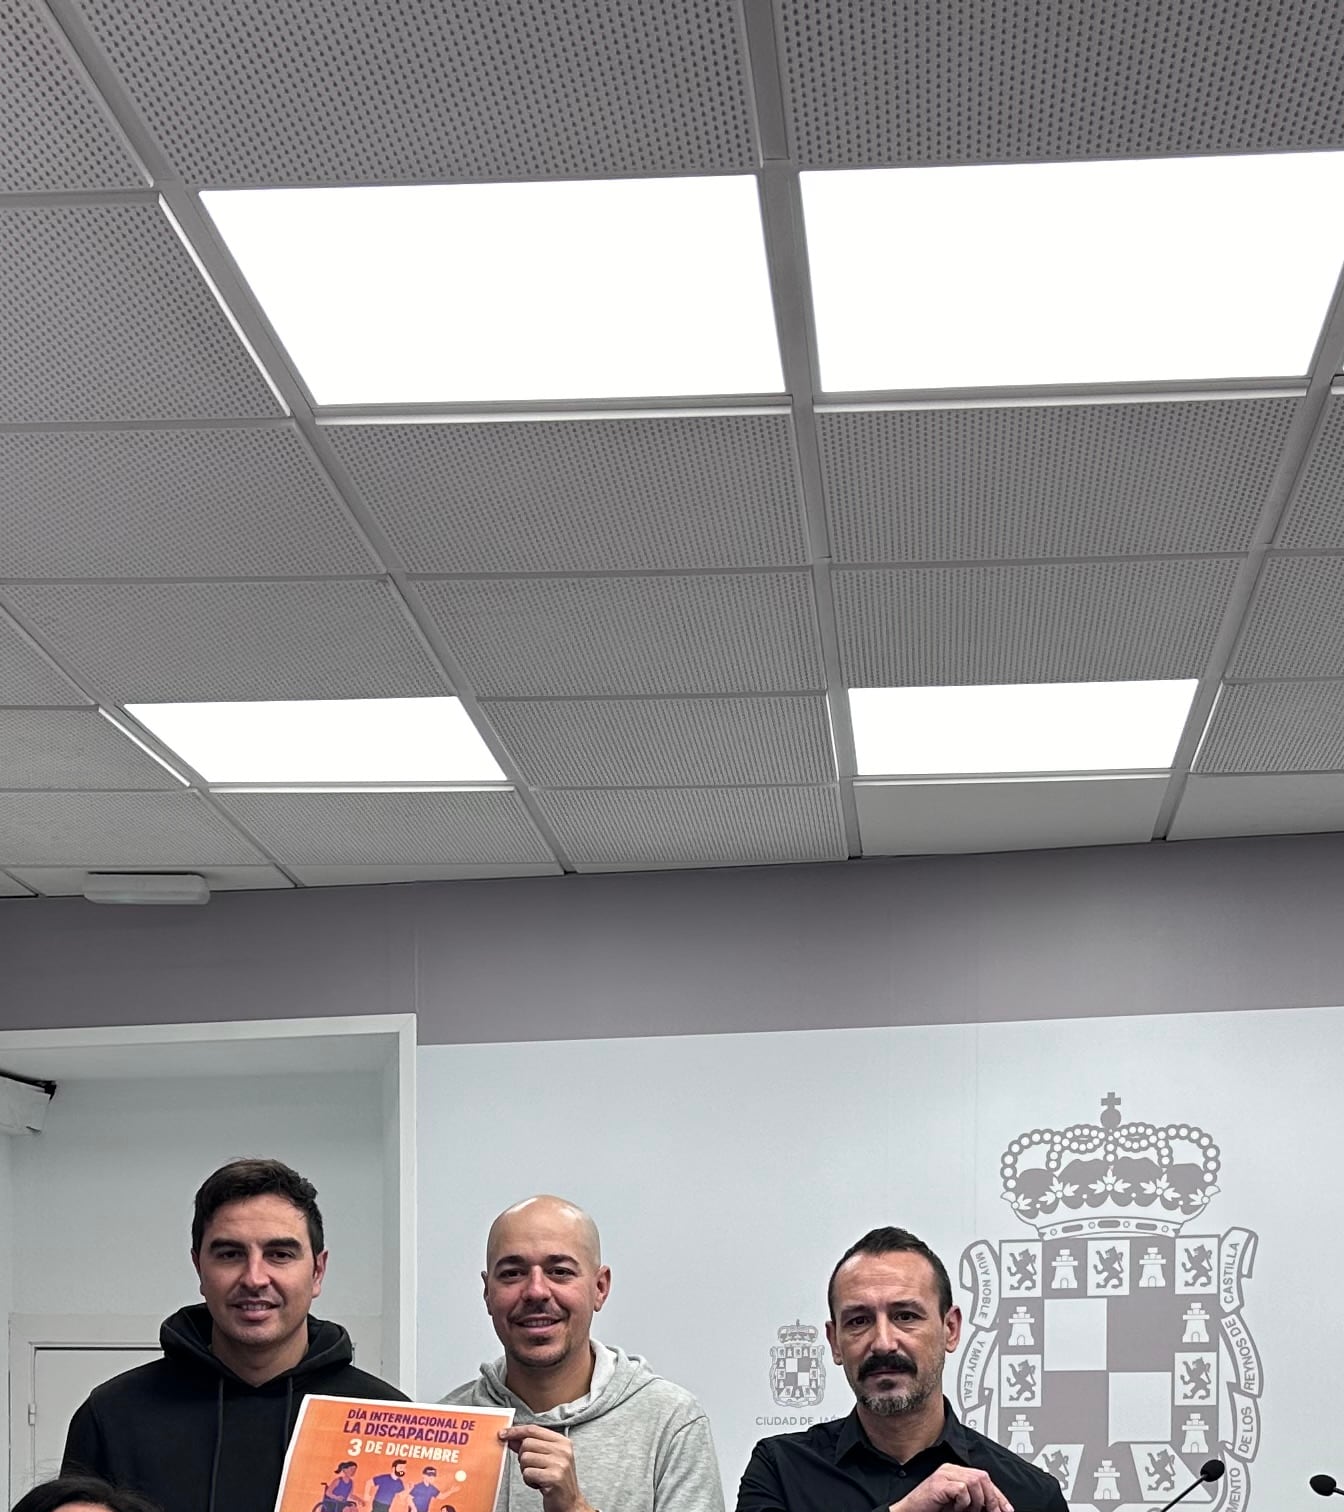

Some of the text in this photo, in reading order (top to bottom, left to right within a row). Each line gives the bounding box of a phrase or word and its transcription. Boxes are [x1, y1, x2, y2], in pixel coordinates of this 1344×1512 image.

[976, 1251, 992, 1319] MUY NOBLE
[1224, 1242, 1240, 1304] CASTILLA
[968, 1348, 981, 1373] MUY
[1225, 1318, 1254, 1391] REYNOS DE
[963, 1373, 976, 1401] LEAL
[343, 1420, 469, 1446] LA DISCAPACIDAD
[347, 1408, 476, 1431] DÍA INTERNACIONAL DE
[756, 1417, 814, 1425] CIUDAD DE
[1238, 1406, 1254, 1453] DE LOS
[348, 1438, 460, 1463] 3 DE DICIEMBRE
